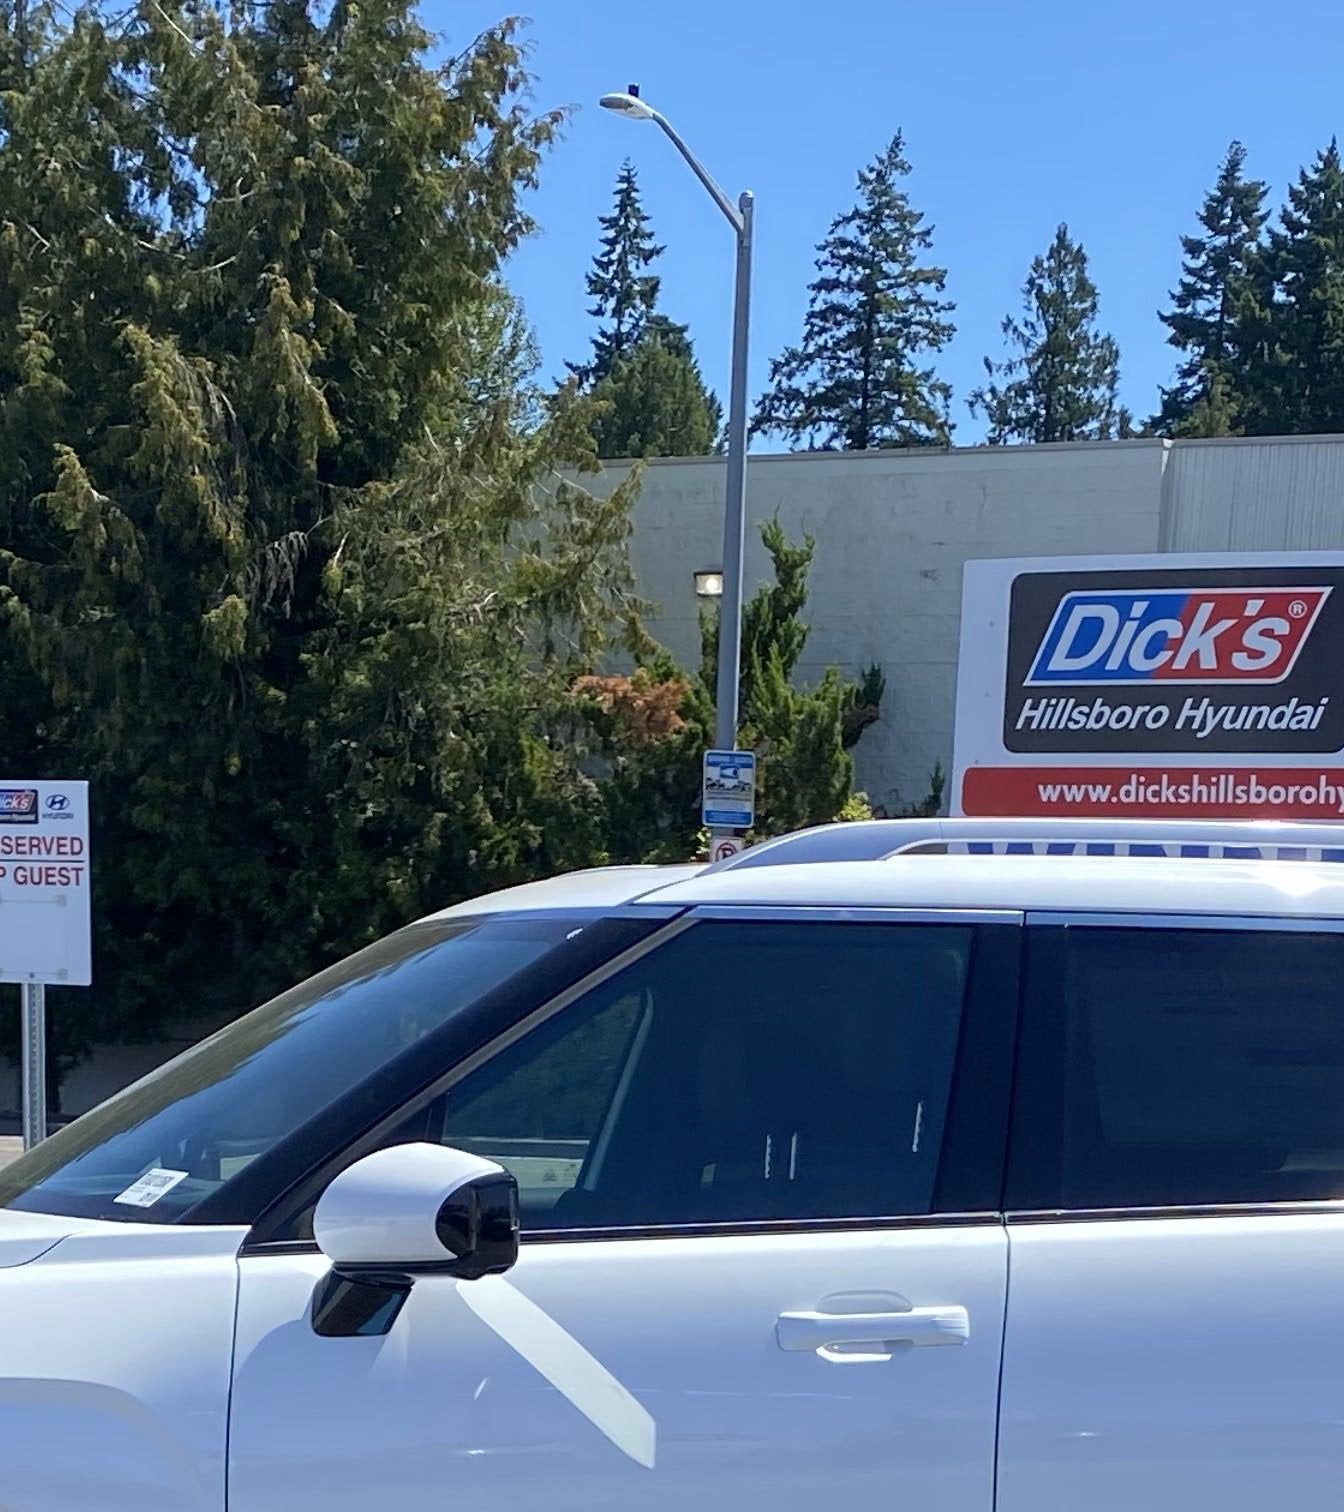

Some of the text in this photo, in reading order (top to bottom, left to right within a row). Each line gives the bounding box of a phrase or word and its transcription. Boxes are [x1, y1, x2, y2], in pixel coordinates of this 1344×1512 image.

[1046, 599, 1291, 672] Dick's
[1015, 696, 1329, 738] Hillsboro Hyundai
[13, 866, 84, 887] GUEST
